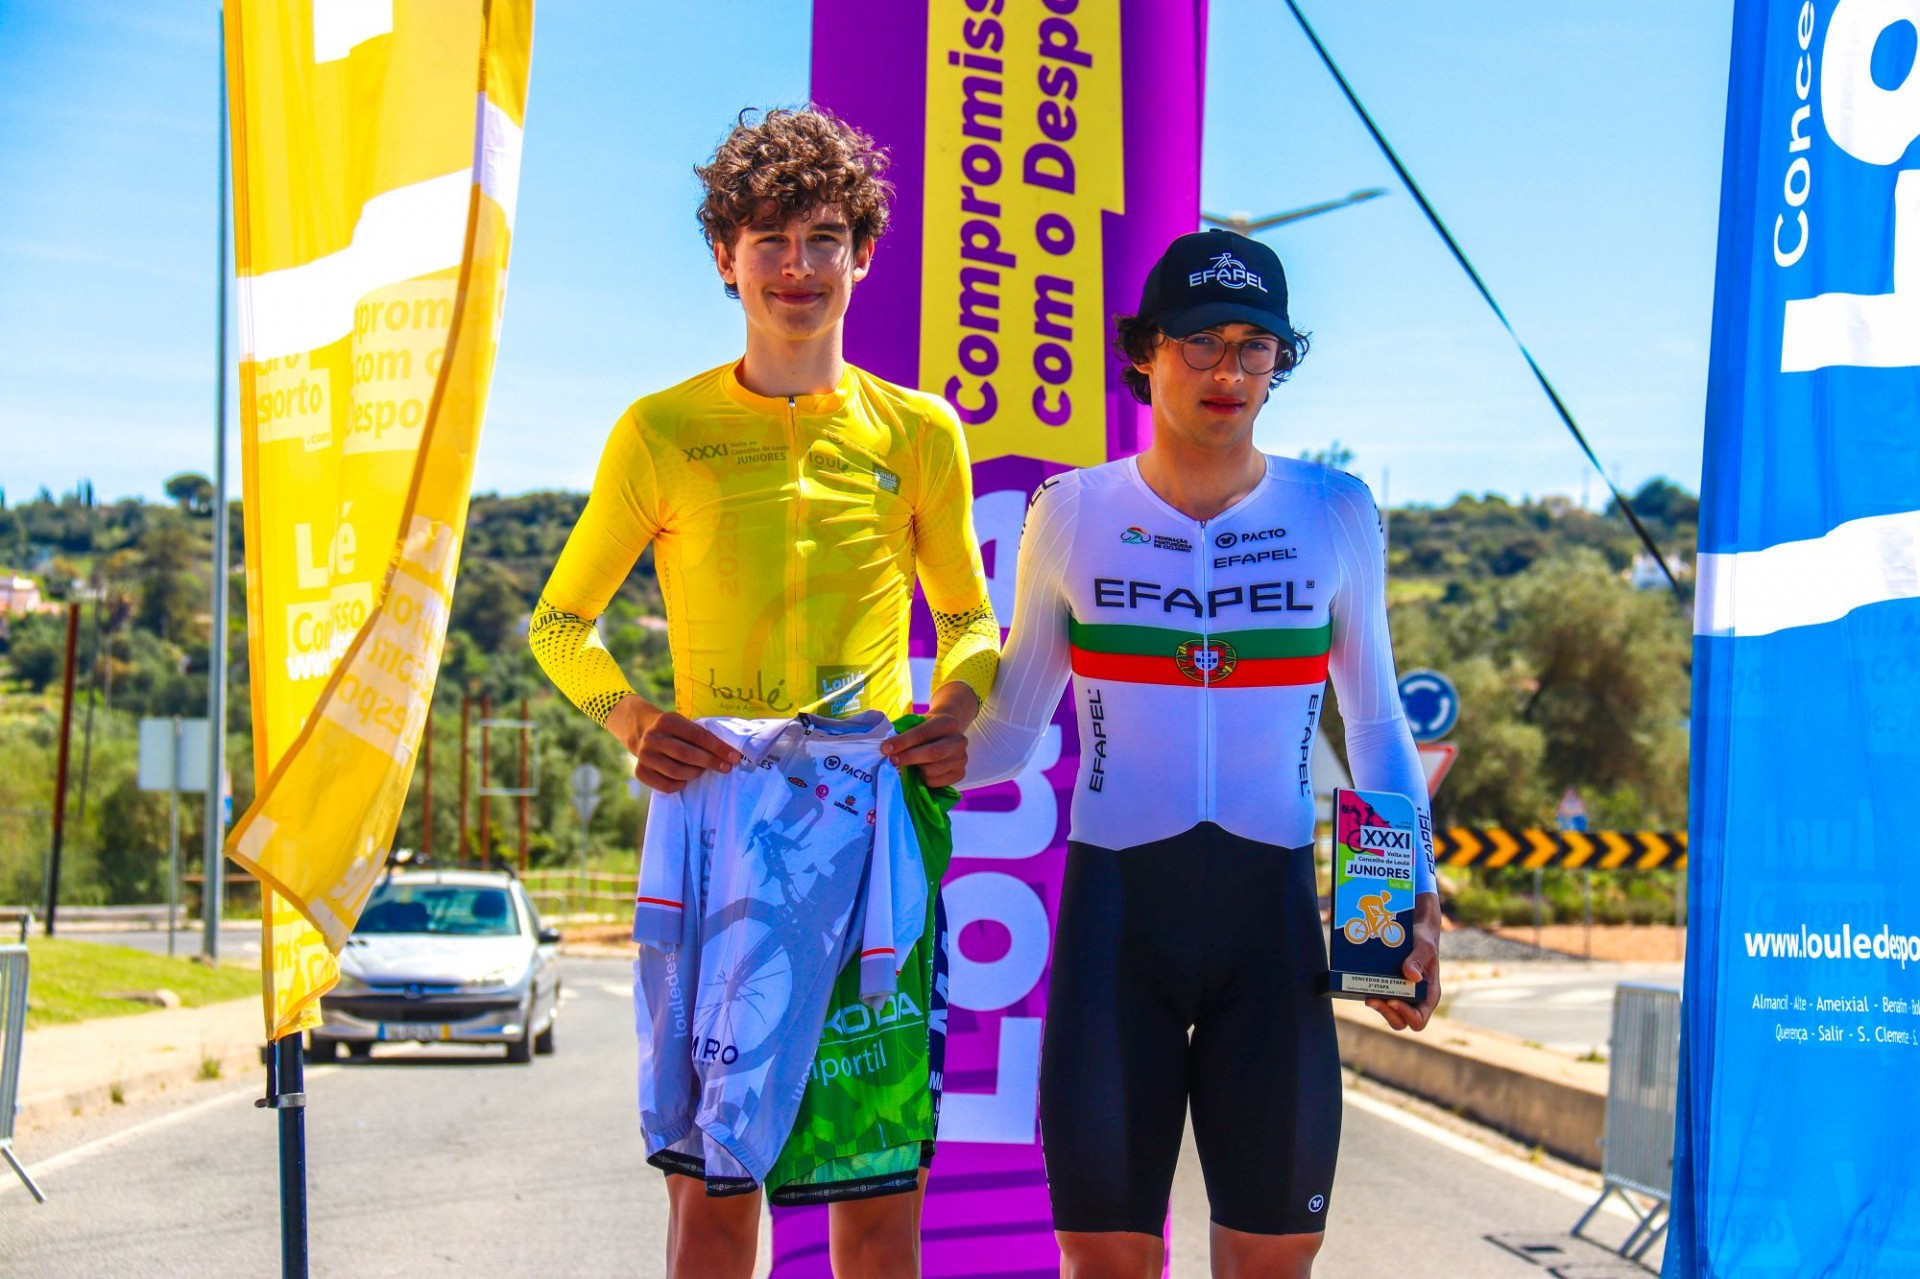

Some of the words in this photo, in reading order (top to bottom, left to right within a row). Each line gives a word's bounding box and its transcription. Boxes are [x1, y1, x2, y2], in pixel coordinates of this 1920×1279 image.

[1035, 213, 1075, 256] o
[1188, 268, 1268, 293] EFAPEL
[1032, 274, 1074, 427] com
[683, 443, 728, 463] XXXI
[737, 452, 786, 465] JUNIORES
[1242, 528, 1286, 543] PACTO
[1214, 549, 1297, 569] EFAPEL
[1094, 578, 1314, 618] EFAPEL
[709, 668, 794, 713] loulé
[1089, 691, 1107, 793] EFAPEL
[1299, 694, 1319, 797] EFAPEL
[841, 763, 873, 784] PACTO
[1363, 829, 1410, 849] XXXI
[1418, 810, 1436, 876] EFAPEL
[1358, 856, 1384, 864] Concelho
[1347, 864, 1410, 879] JUNIORES
[1816, 996, 1869, 1013] Ameixial
[1818, 1025, 1844, 1042] Salir
[1857, 1026, 1870, 1043] S.
